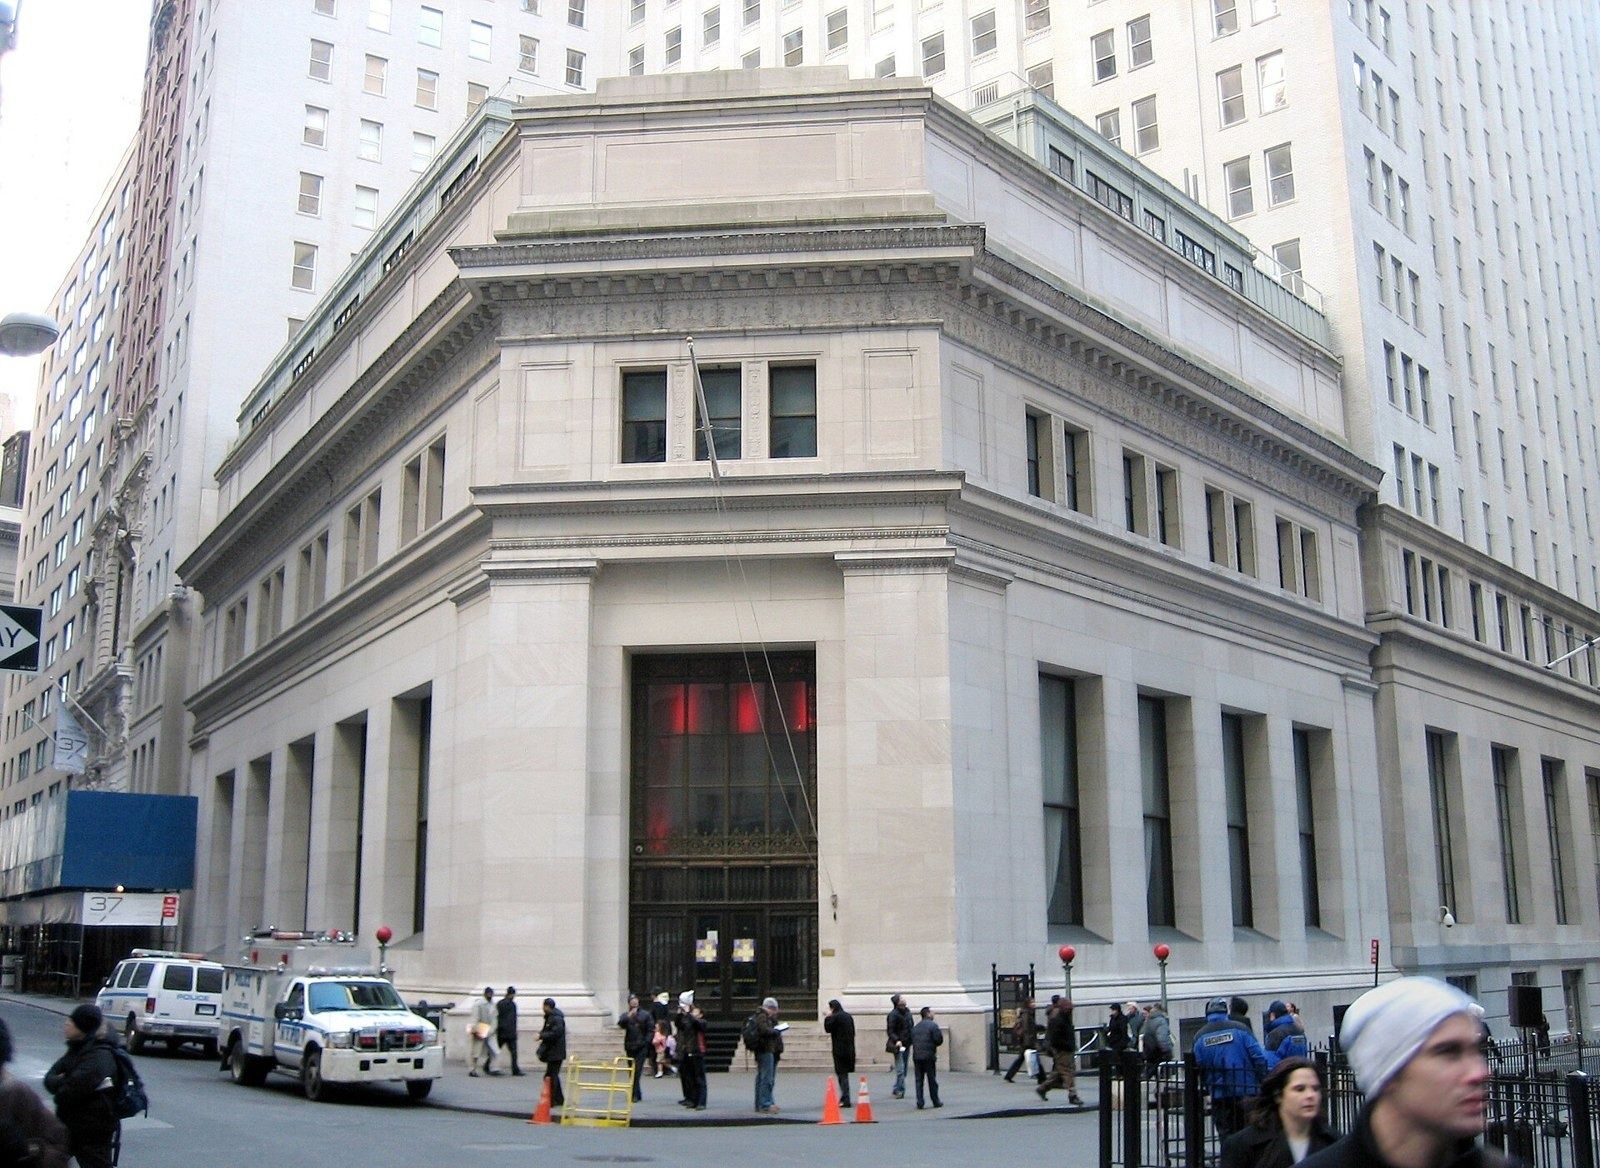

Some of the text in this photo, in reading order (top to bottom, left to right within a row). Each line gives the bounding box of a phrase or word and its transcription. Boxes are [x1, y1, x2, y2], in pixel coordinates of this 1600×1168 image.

[0, 627, 21, 648] Y
[59, 737, 87, 760] 37
[90, 896, 123, 922] 37
[176, 993, 209, 1002] POLICE
